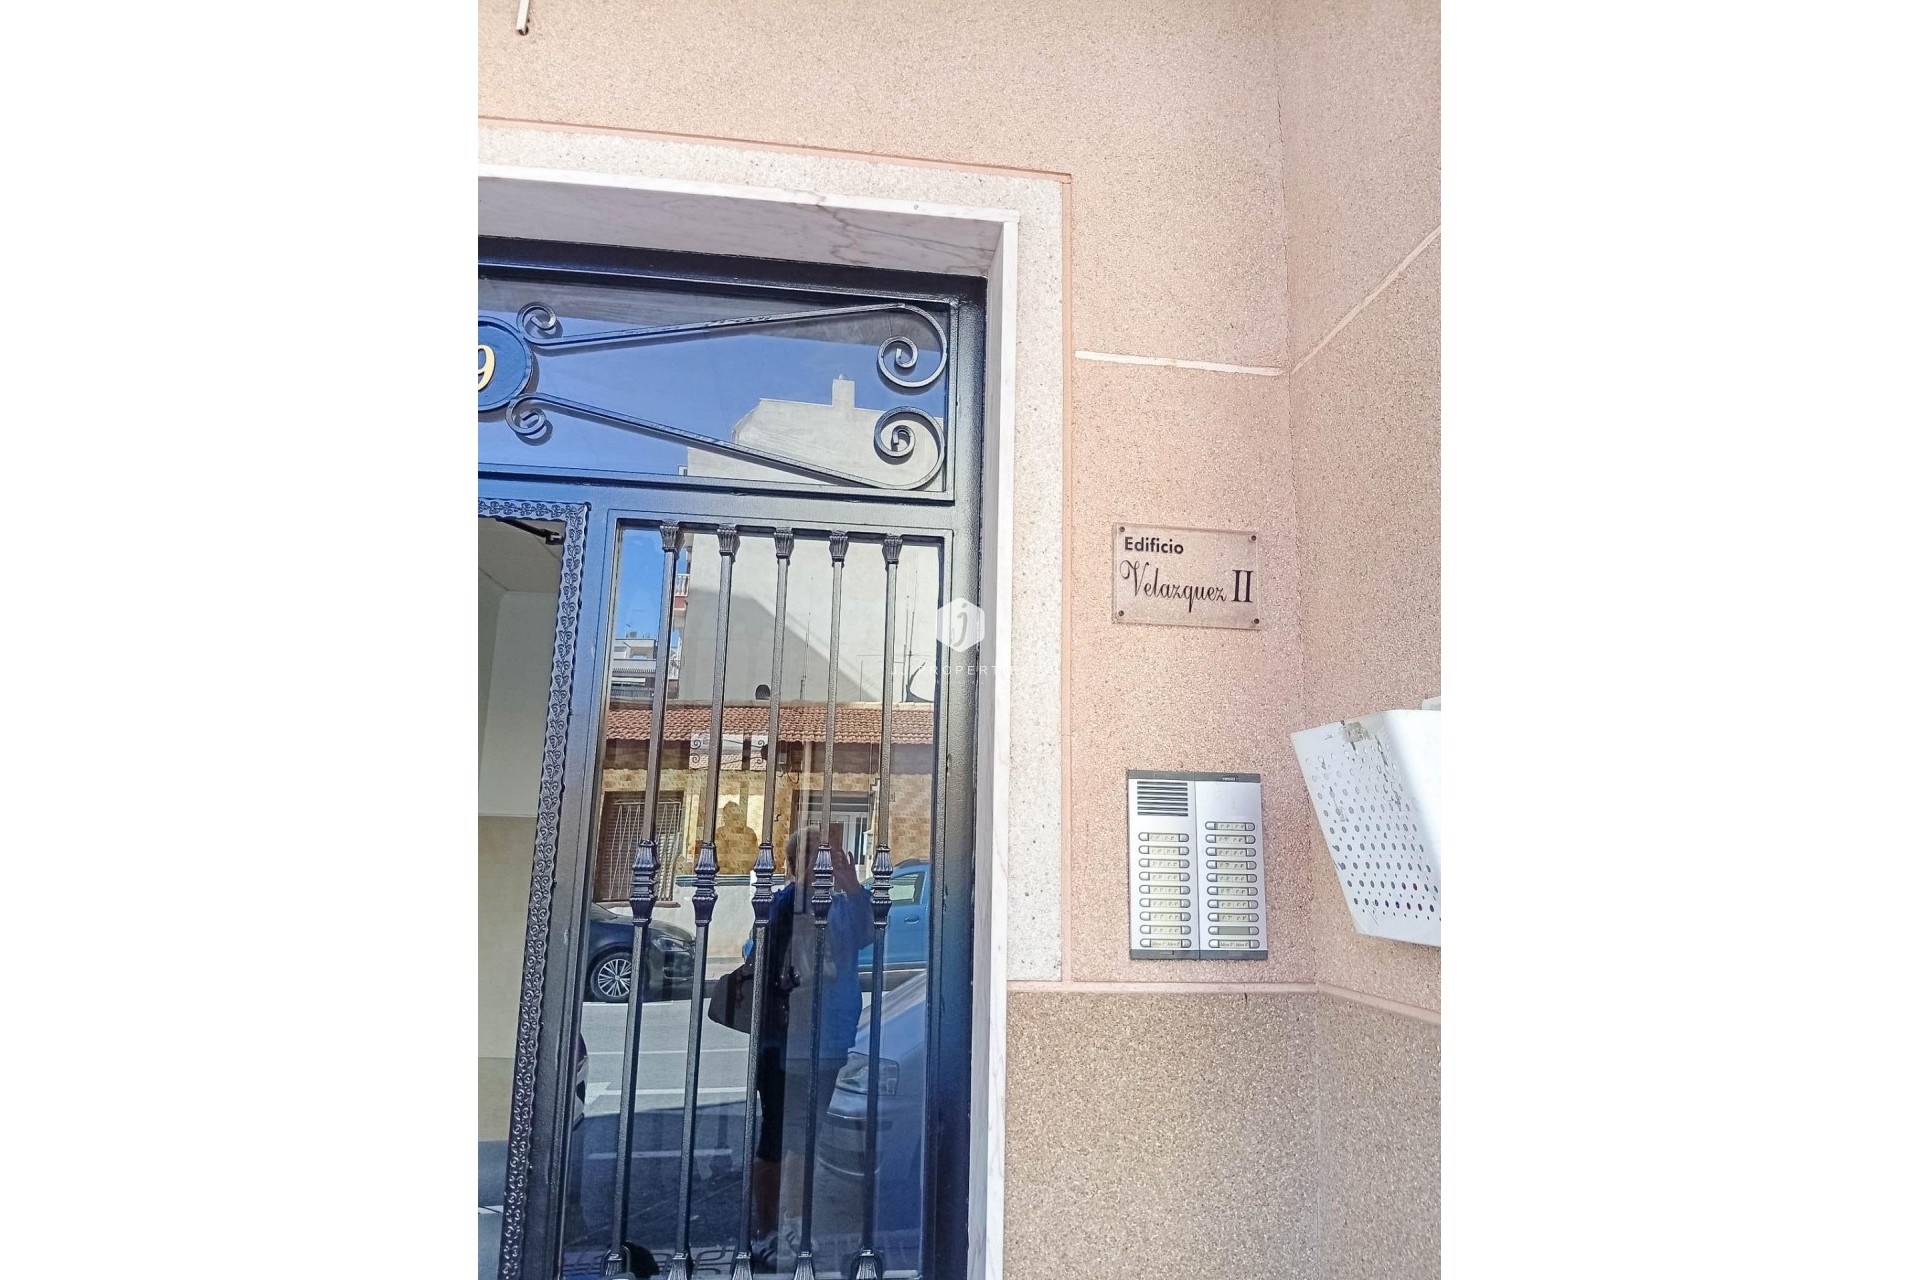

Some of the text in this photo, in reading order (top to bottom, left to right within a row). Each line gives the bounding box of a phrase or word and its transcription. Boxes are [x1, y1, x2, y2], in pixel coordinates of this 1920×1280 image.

[1124, 536, 1184, 554] Edificio
[1119, 559, 1254, 612] Velazquez II
